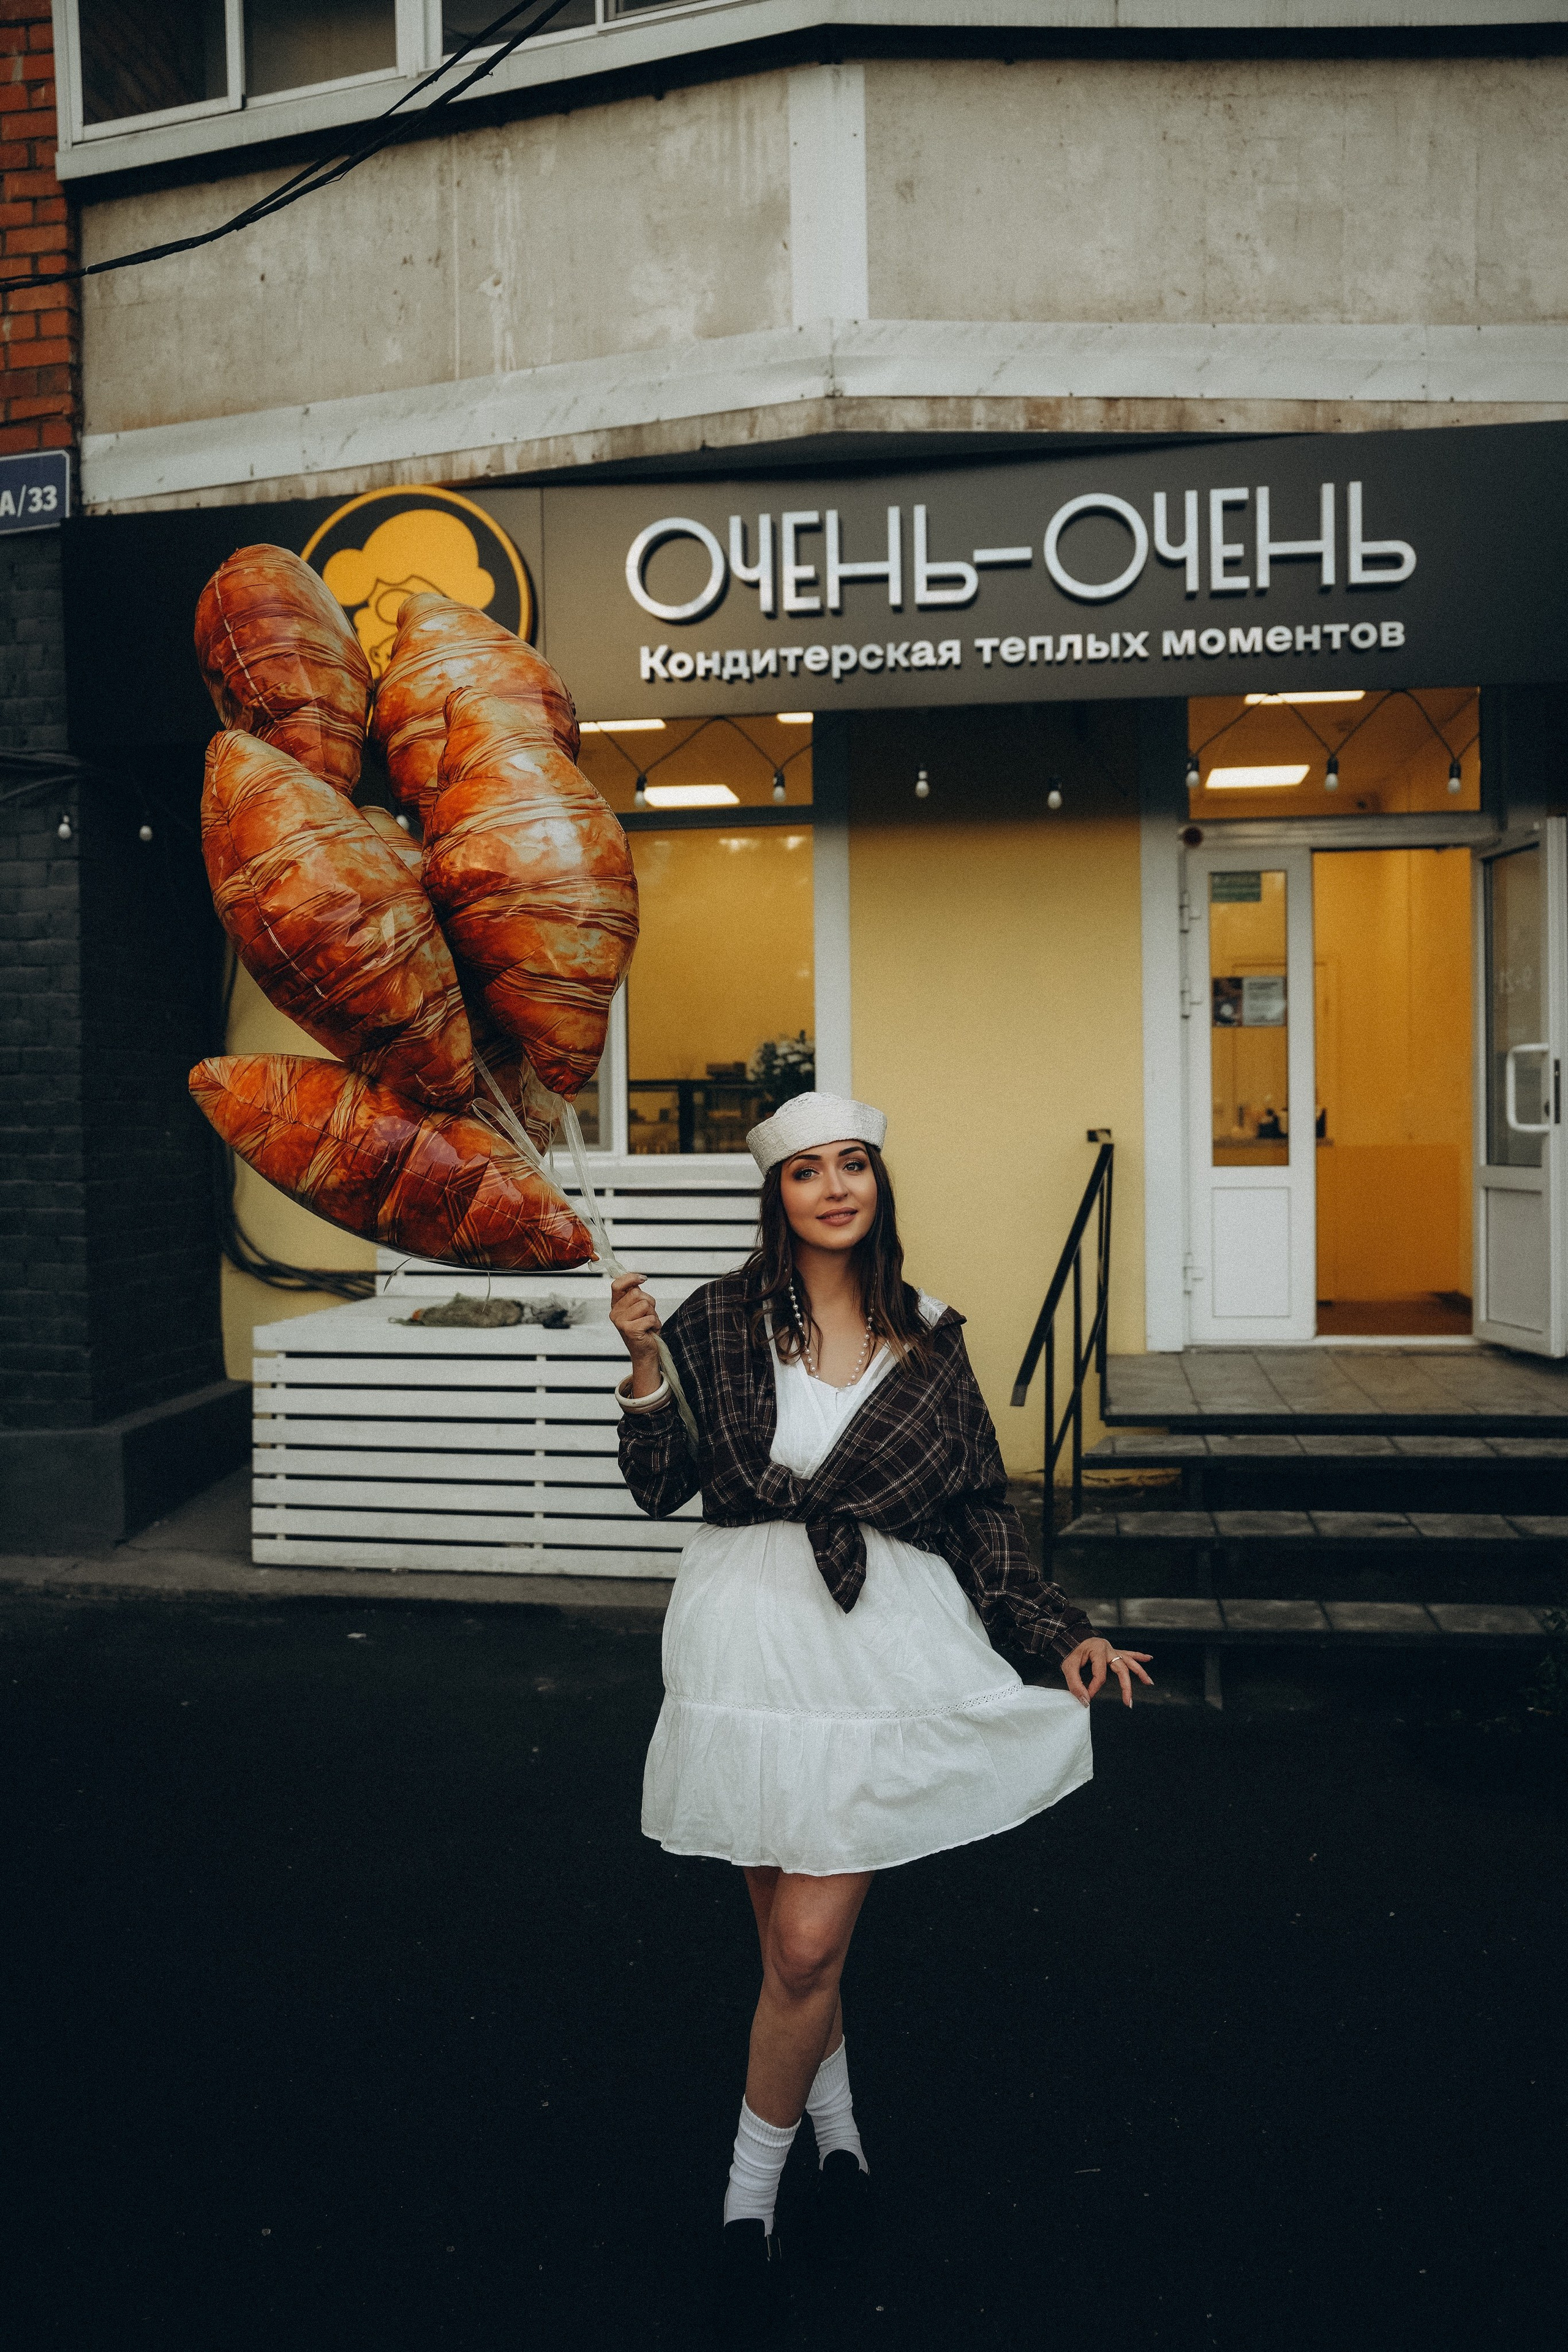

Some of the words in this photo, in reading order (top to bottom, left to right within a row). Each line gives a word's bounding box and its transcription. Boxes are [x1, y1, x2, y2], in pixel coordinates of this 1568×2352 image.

[625, 481, 1417, 620] ОЧЕНЬ-ОЧЕНЬ
[639, 639, 961, 680] Кондитерская
[974, 632, 1149, 663] теплых
[1162, 622, 1405, 656] моментов
